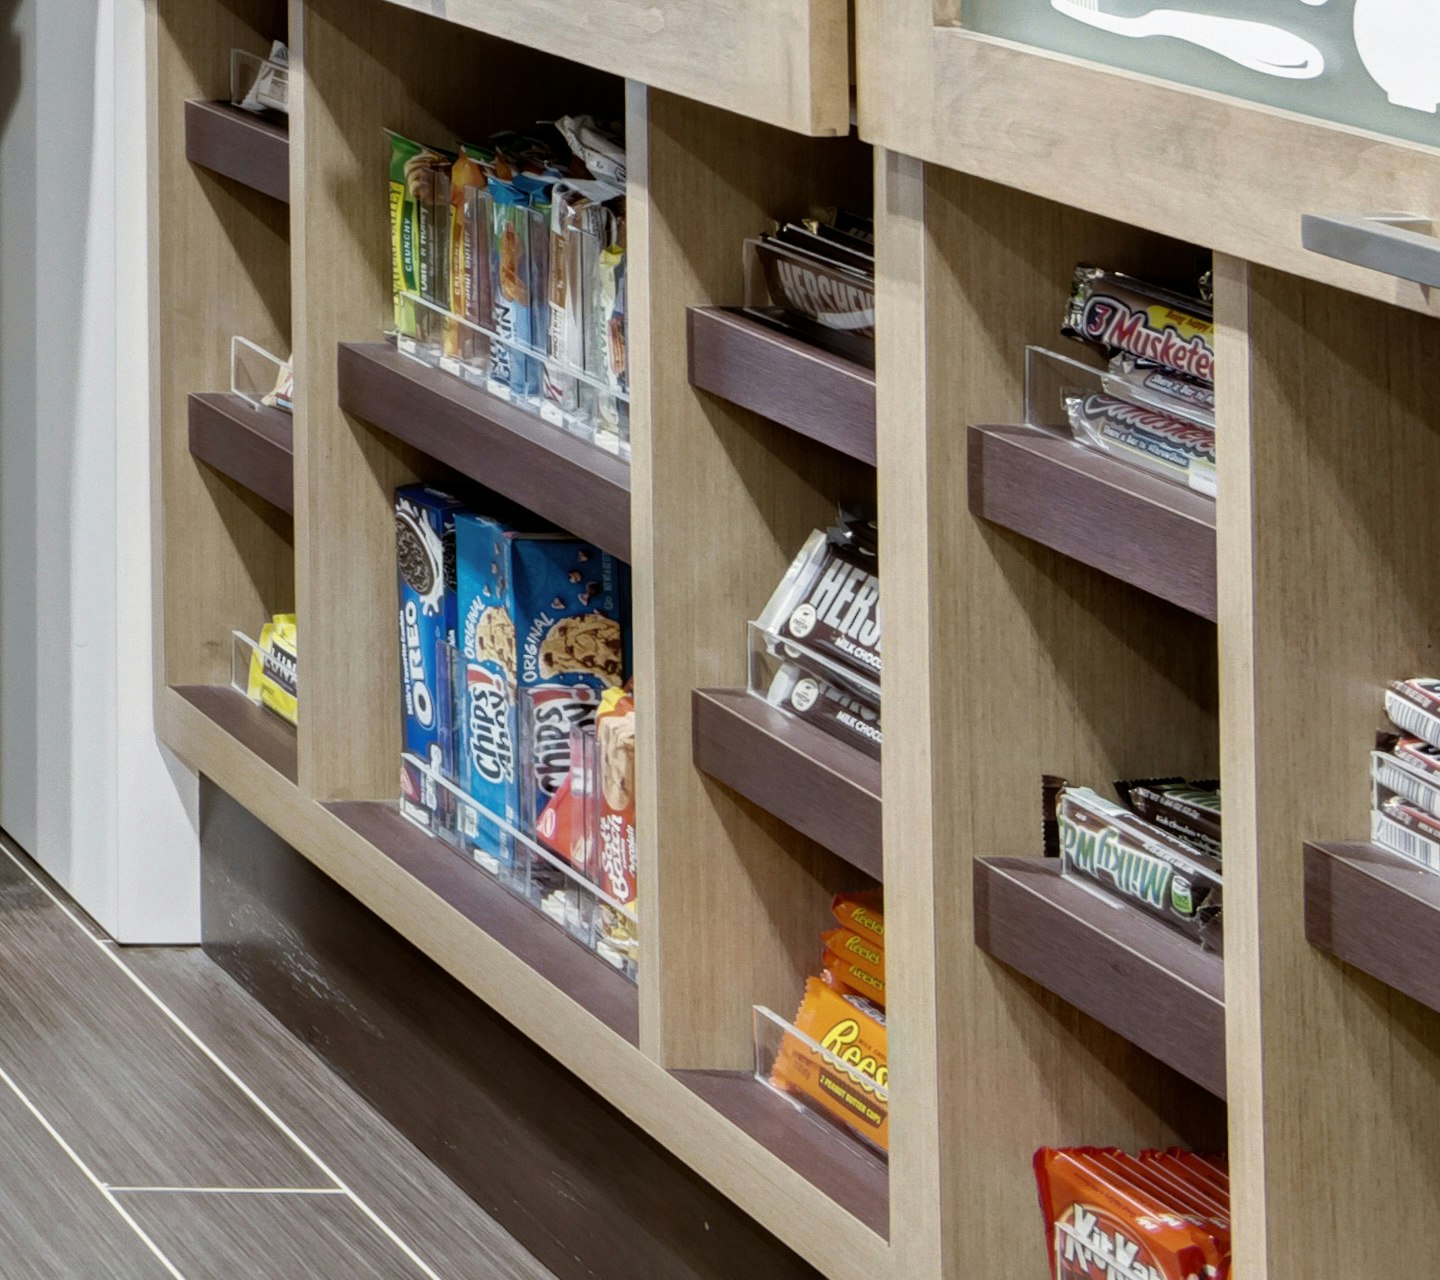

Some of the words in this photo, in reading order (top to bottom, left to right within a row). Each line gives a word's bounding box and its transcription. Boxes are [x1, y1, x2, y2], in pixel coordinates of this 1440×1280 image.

[404, 218, 413, 273] CRUNCHY
[1087, 303, 1111, 336] 3
[463, 595, 486, 660] ORIGINAL
[522, 612, 555, 682] ORIGINAL
[834, 637, 855, 654] MILK
[406, 600, 435, 729] OREO
[835, 710, 856, 727] MILK
[824, 1077, 846, 1101] PEANUT
[845, 1092, 867, 1114] BUTTER
[866, 1106, 882, 1125] CUPS
[1064, 1203, 1114, 1273] Kit
